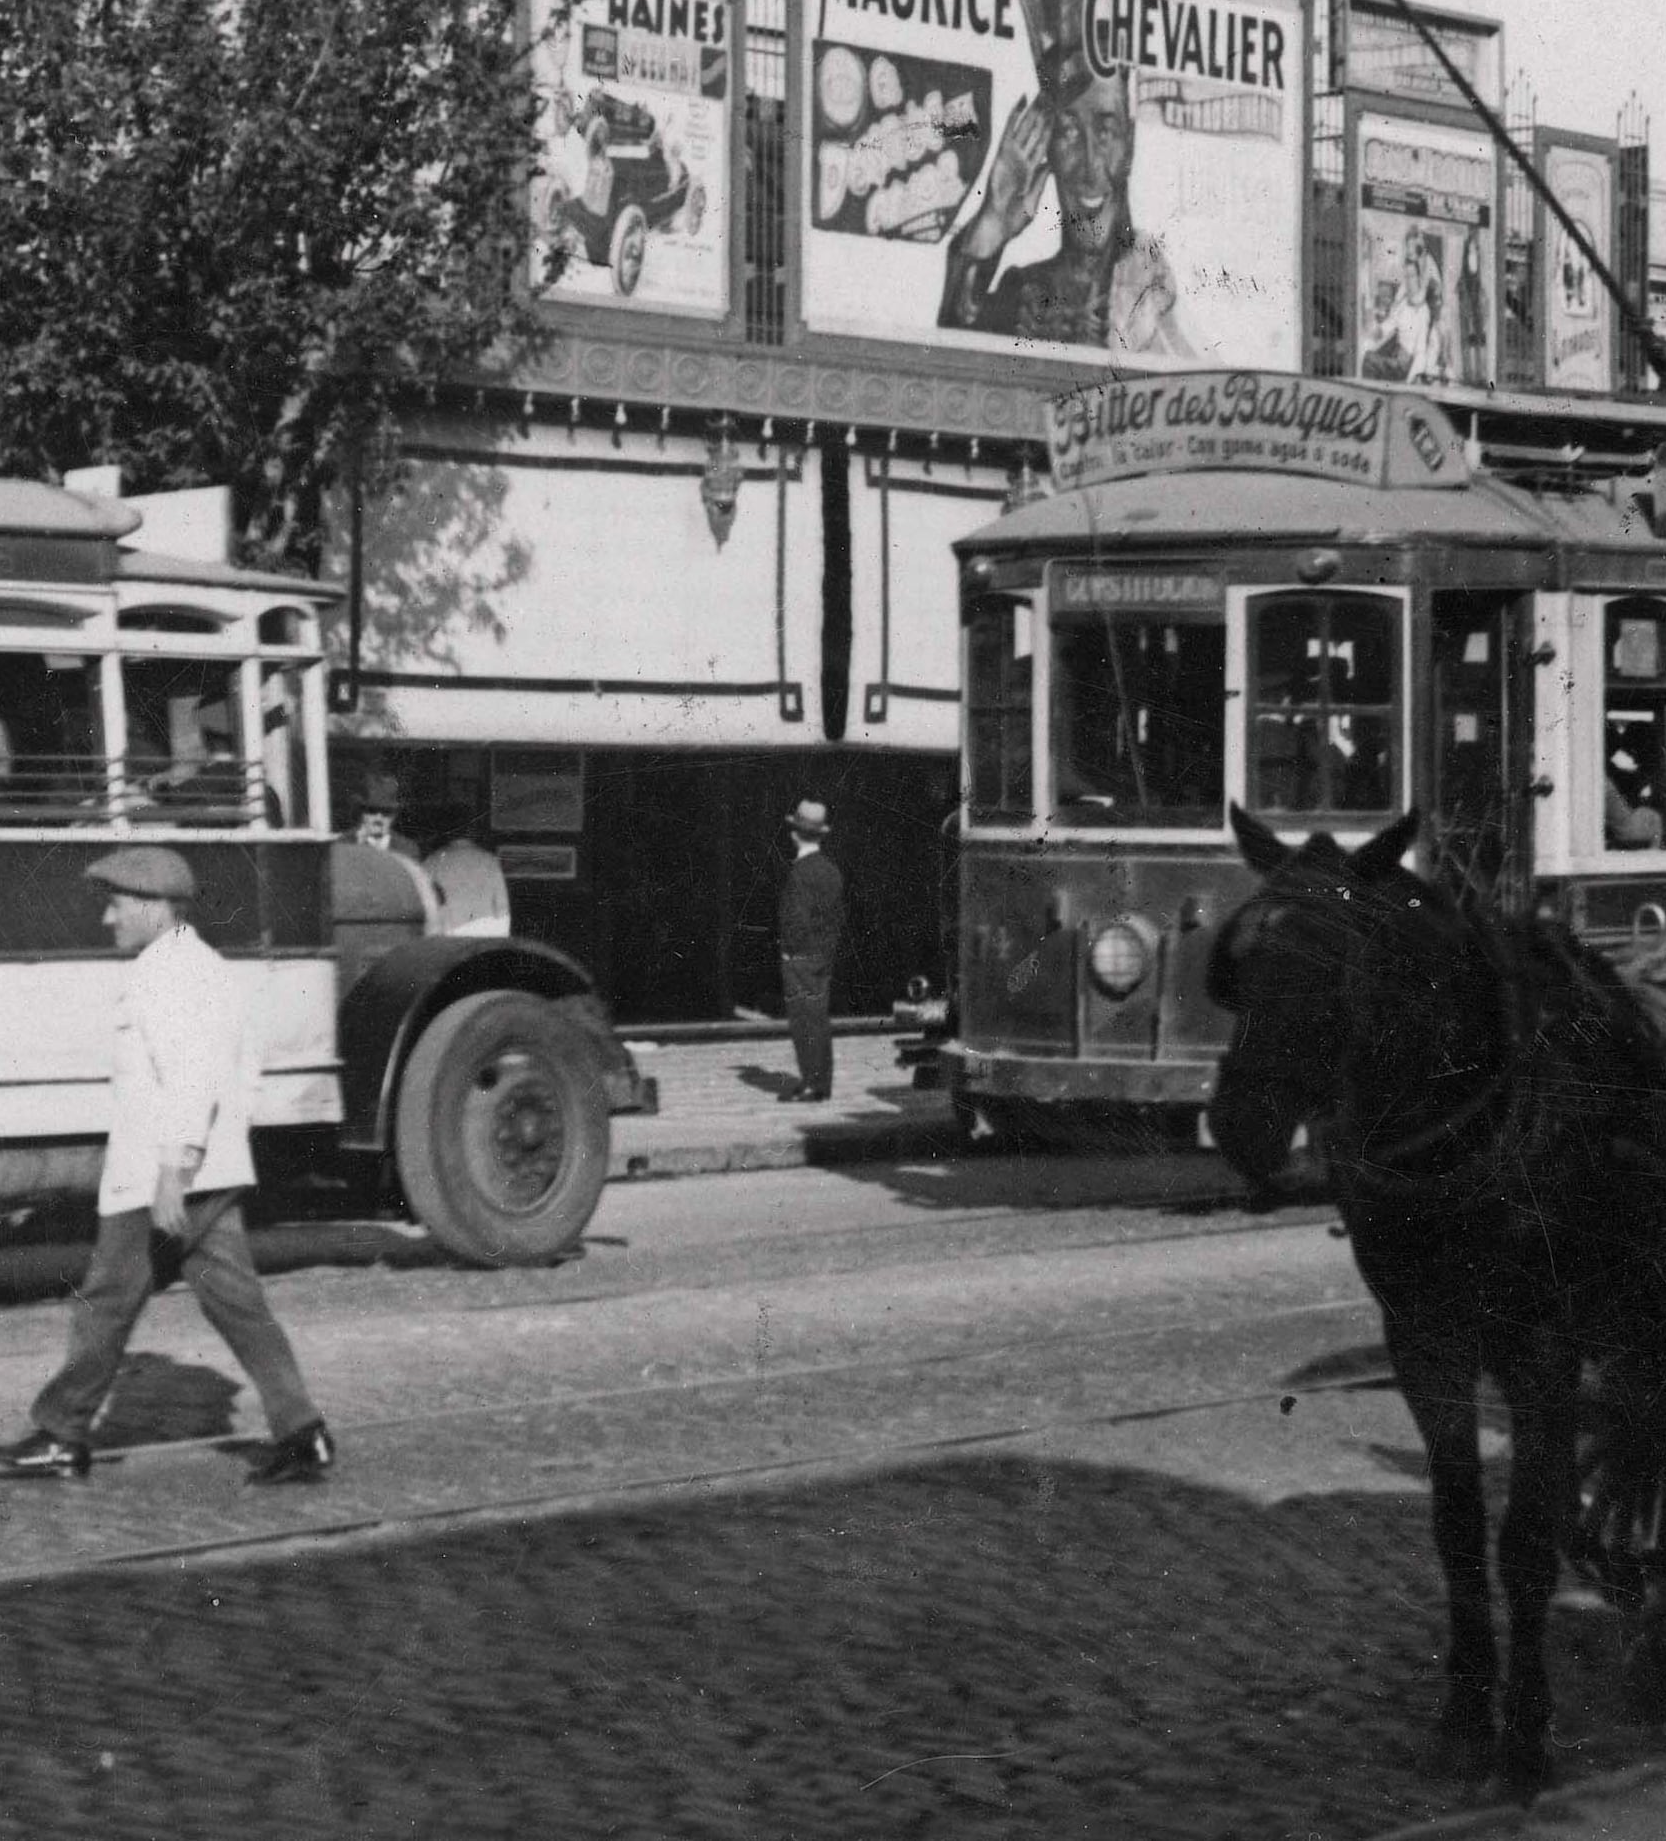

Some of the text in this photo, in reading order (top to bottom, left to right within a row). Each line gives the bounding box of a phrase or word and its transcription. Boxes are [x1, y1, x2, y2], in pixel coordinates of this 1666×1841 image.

[1053, 385, 1165, 456] Bitter
[1165, 387, 1218, 428] des
[1217, 372, 1385, 444] Basques
